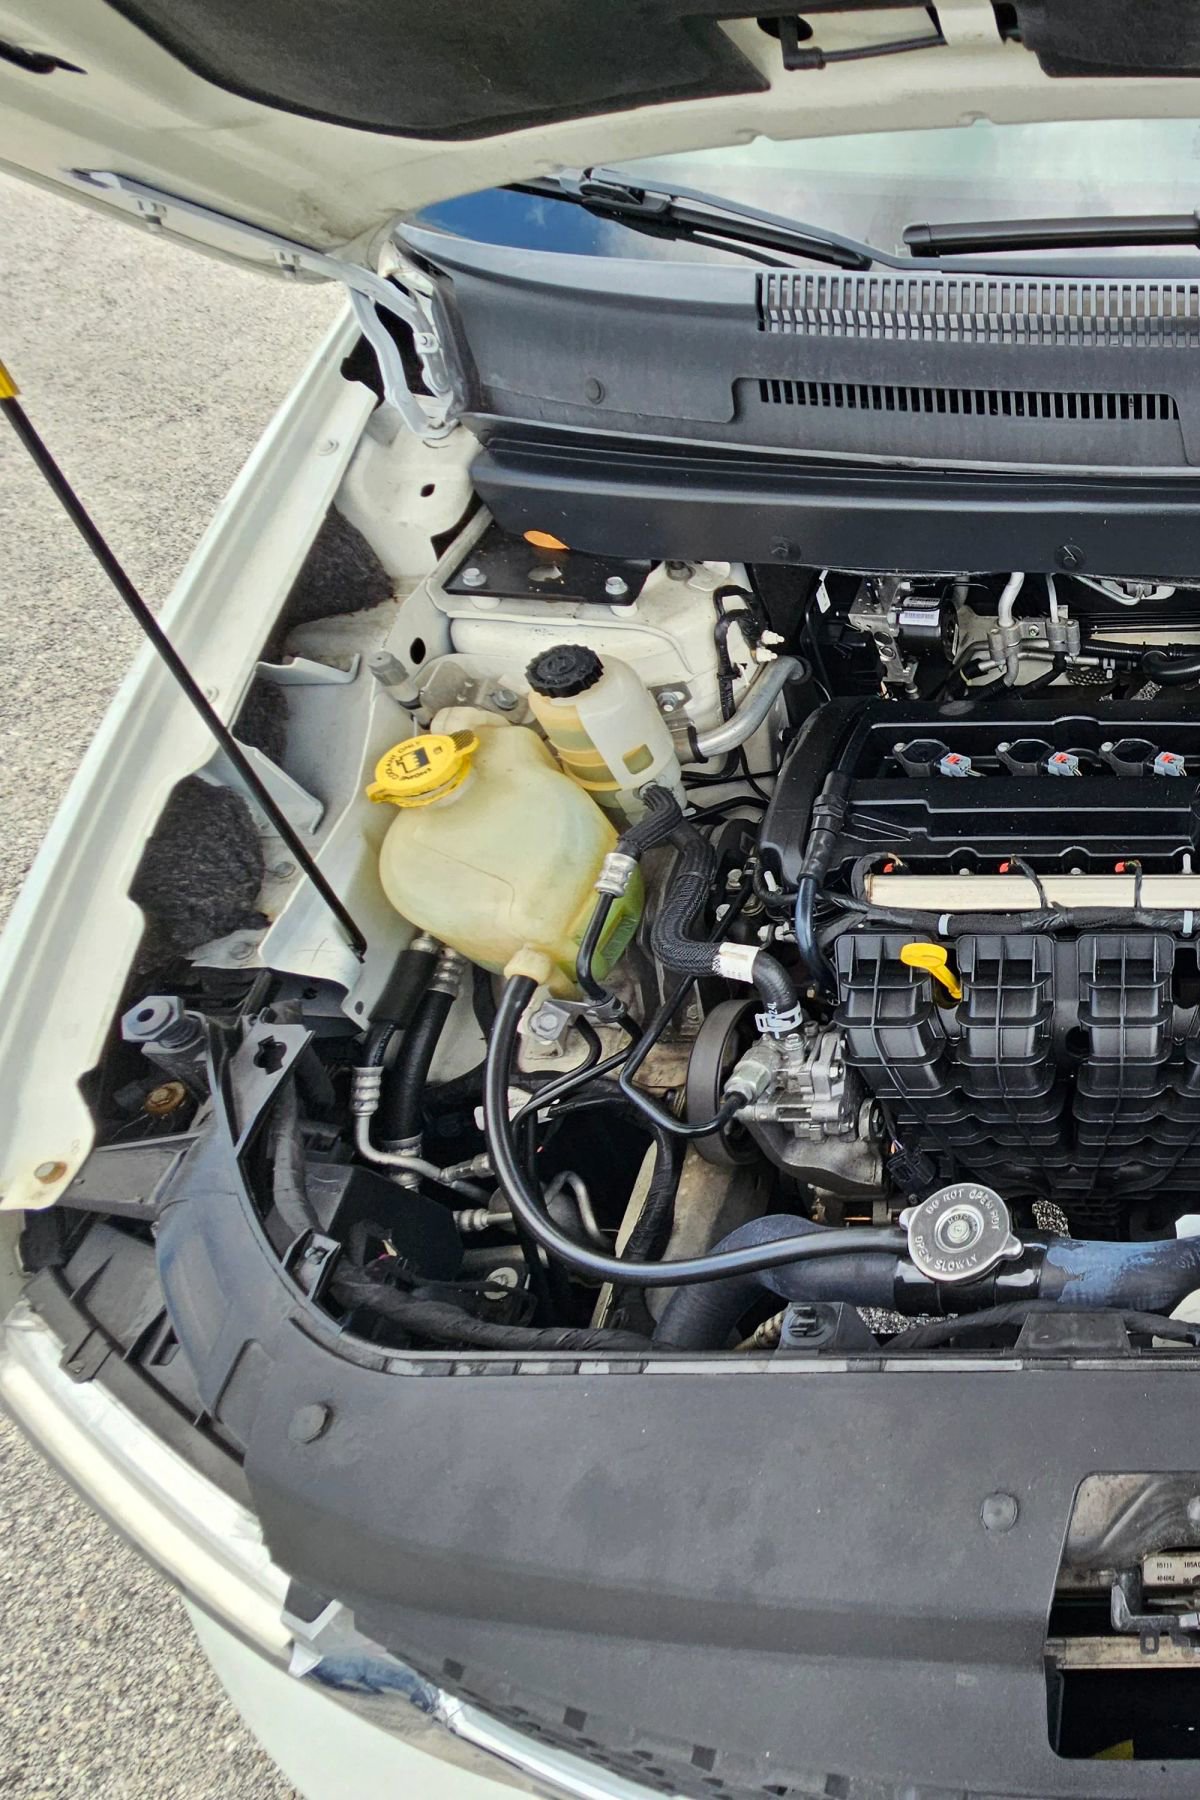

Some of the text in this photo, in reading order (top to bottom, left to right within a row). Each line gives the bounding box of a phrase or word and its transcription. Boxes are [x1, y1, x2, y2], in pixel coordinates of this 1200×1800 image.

[925, 1188, 1001, 1231] DO NOT OPEN HOT
[914, 1234, 978, 1272] OPEN SLOWLY
